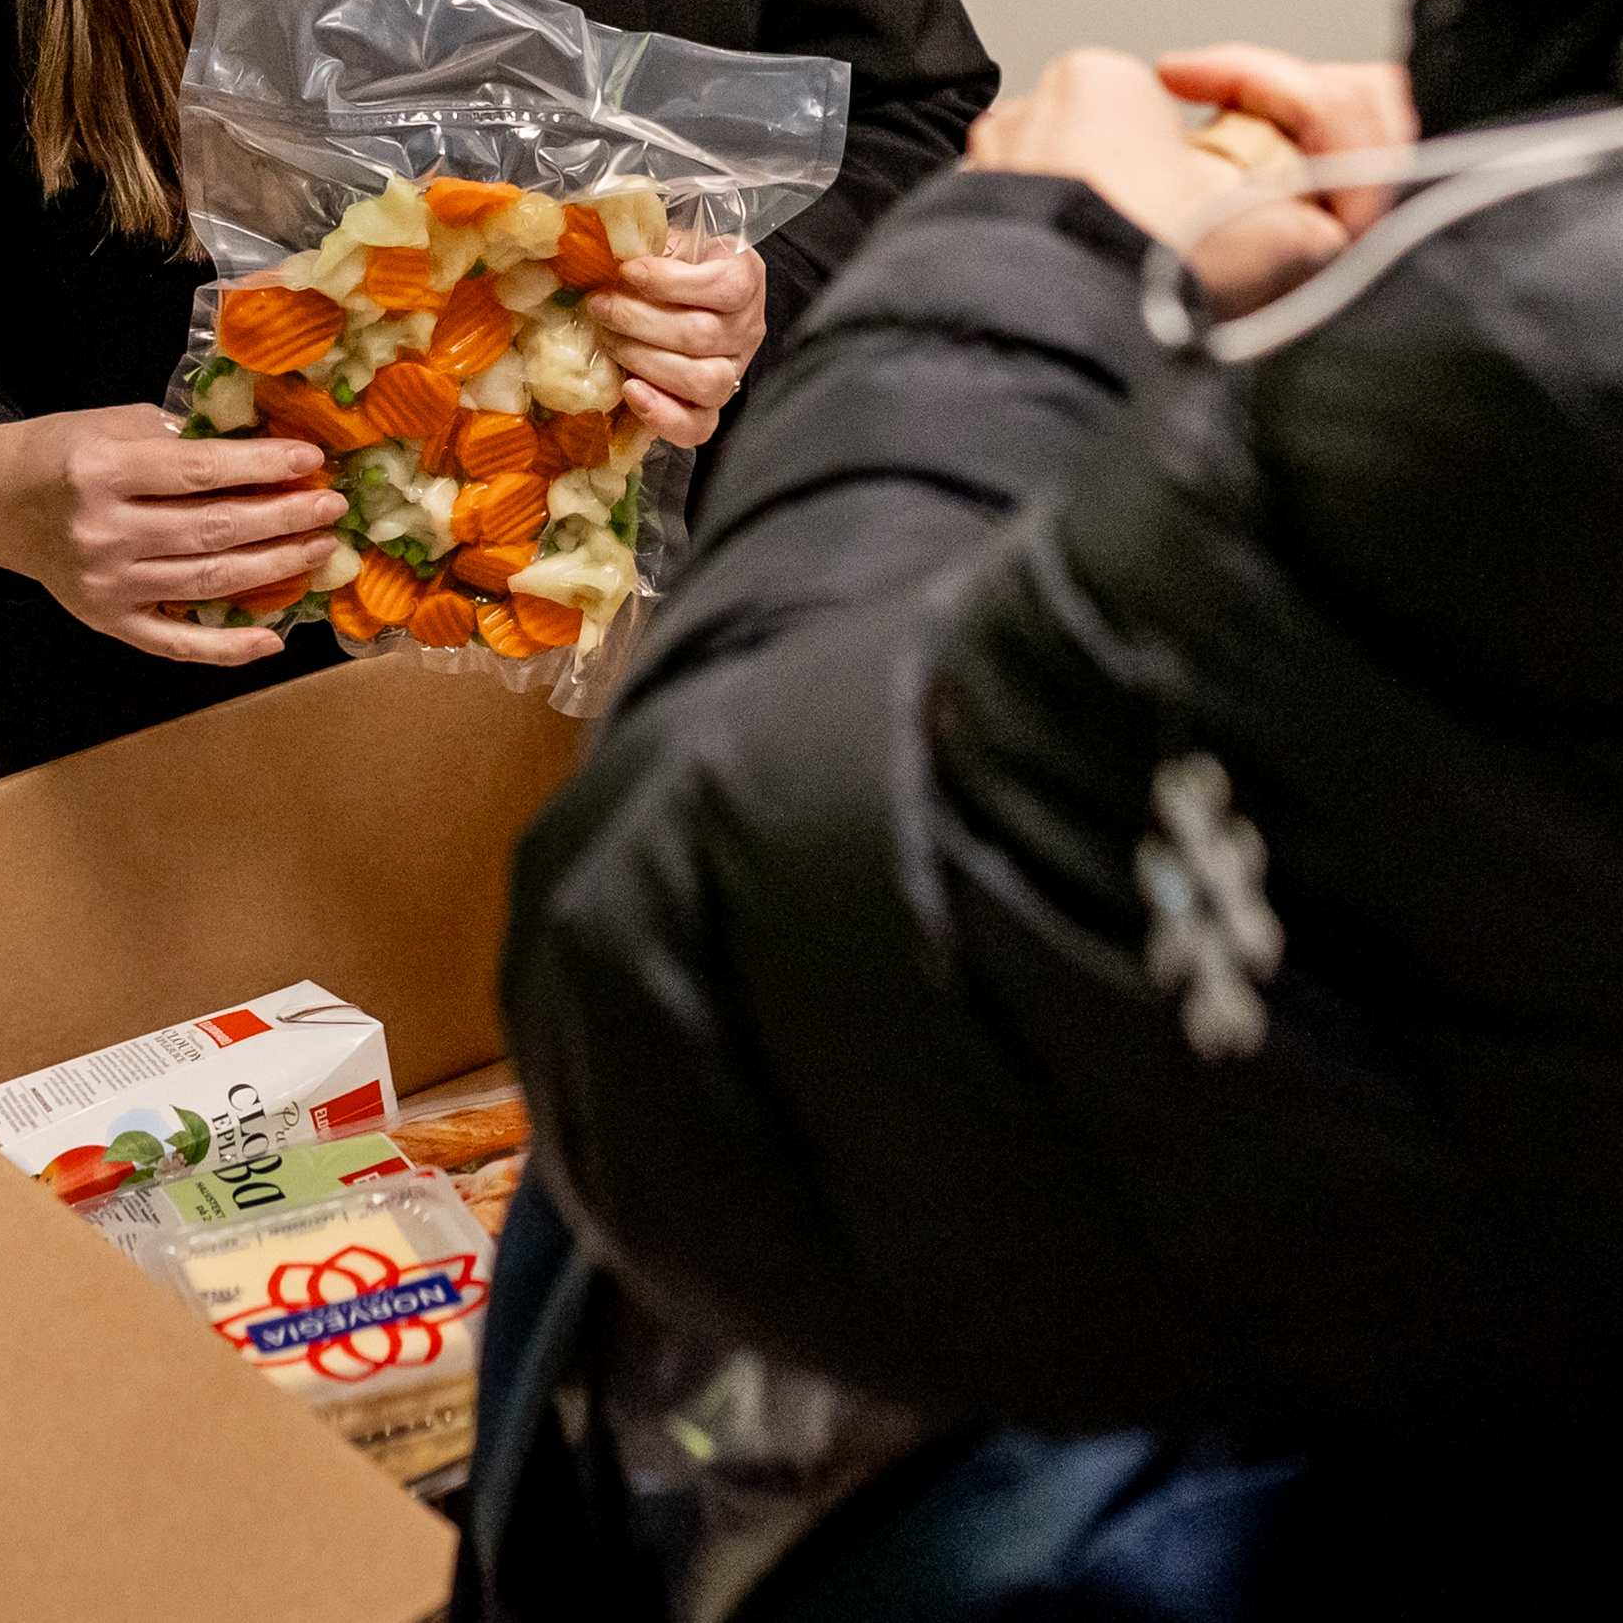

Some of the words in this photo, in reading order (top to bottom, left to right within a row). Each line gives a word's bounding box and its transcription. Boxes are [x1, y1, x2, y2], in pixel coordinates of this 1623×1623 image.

[228, 1083, 270, 1159] CLO
[212, 1154, 286, 1209] Ba
[262, 1284, 447, 1347] NORVEGIA
